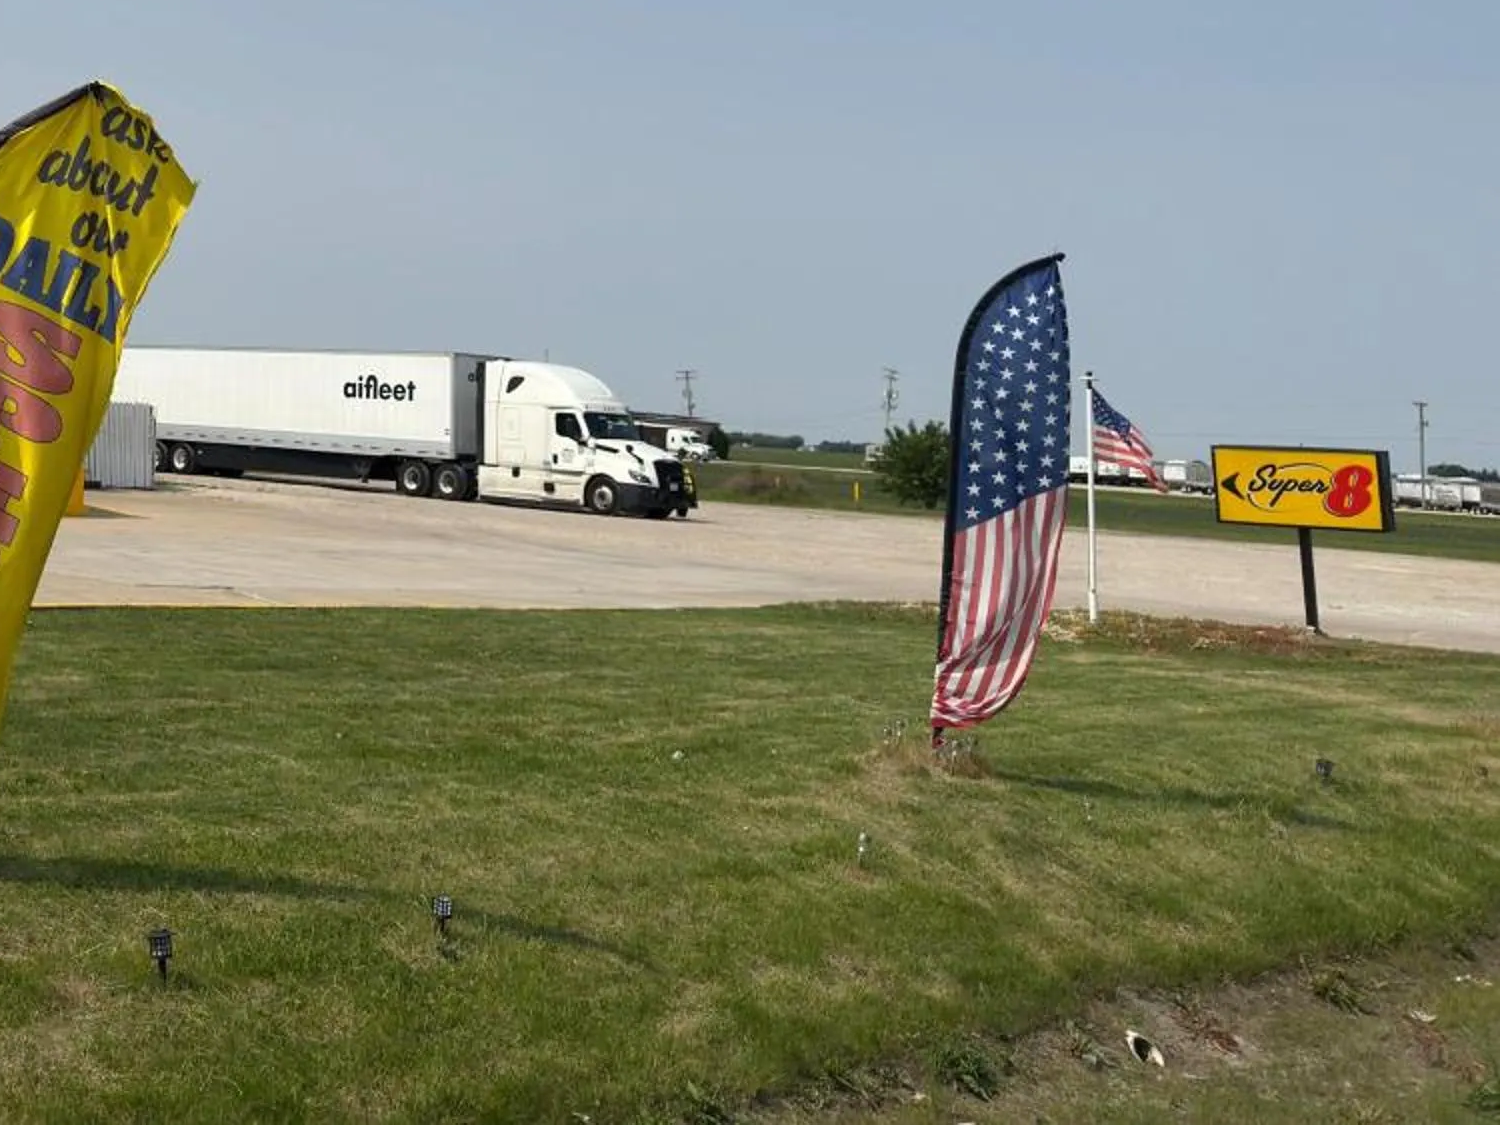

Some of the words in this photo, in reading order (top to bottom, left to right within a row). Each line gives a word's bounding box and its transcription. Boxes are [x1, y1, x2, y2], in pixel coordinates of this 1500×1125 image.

[37, 135, 159, 216] about
[71, 211, 129, 258] our
[343, 374, 416, 401] aifleet
[1249, 464, 1329, 507] Super
[1324, 464, 1373, 517] 8
